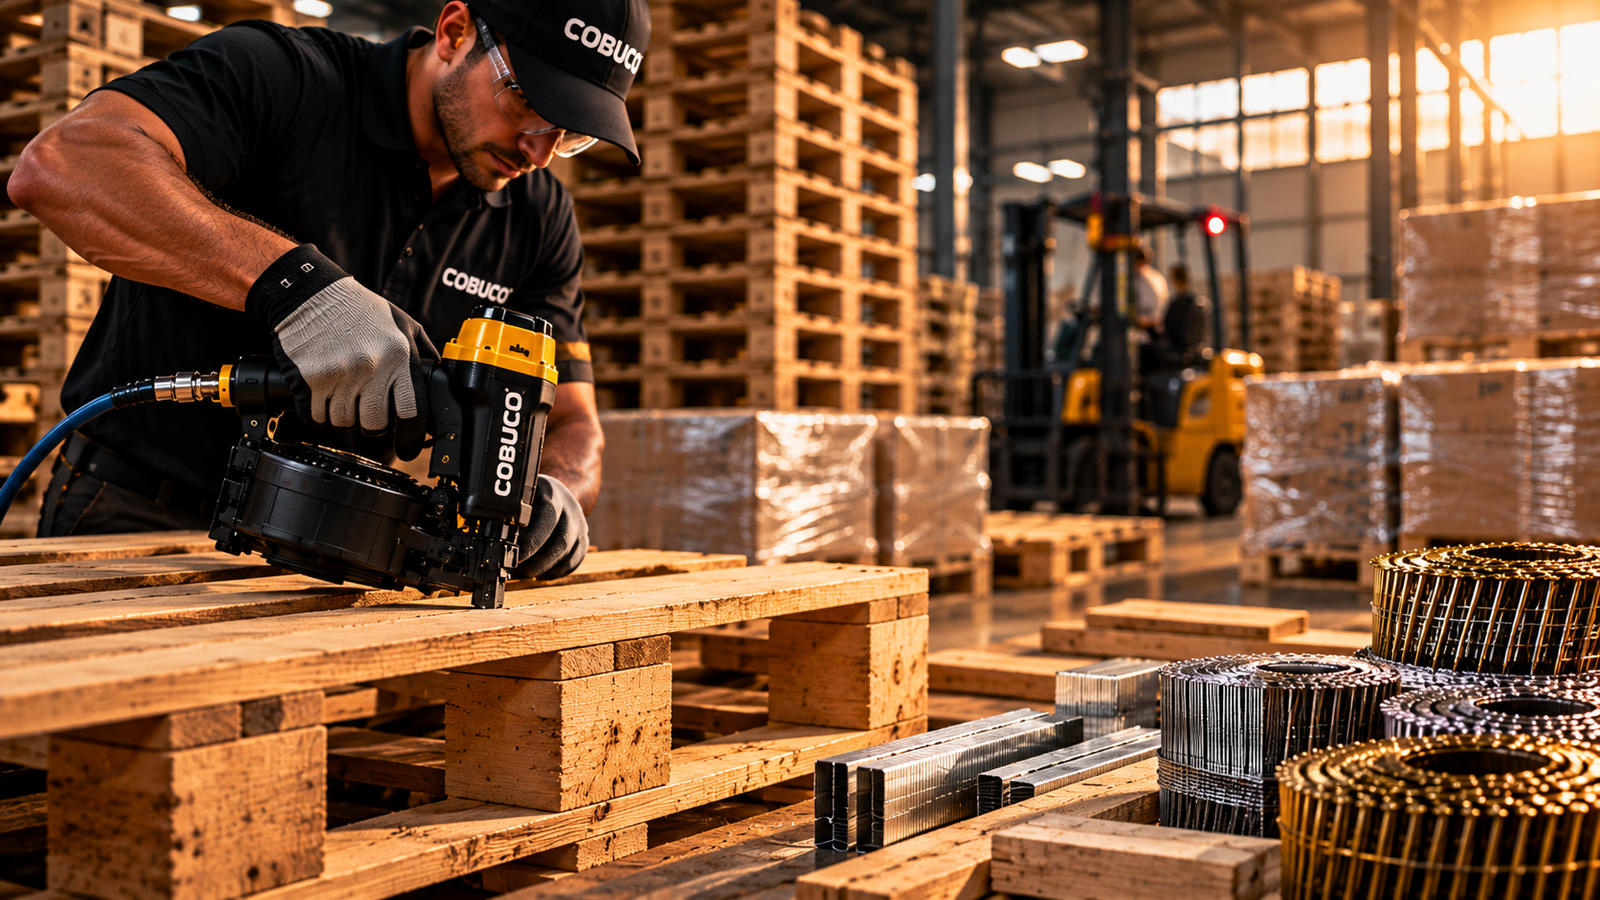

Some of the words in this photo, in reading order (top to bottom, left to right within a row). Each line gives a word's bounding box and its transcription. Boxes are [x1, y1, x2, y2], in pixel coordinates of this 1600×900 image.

[563, 17, 643, 75] COBUCO
[442, 267, 511, 305] COBUCO
[494, 391, 523, 497] COBUCO
